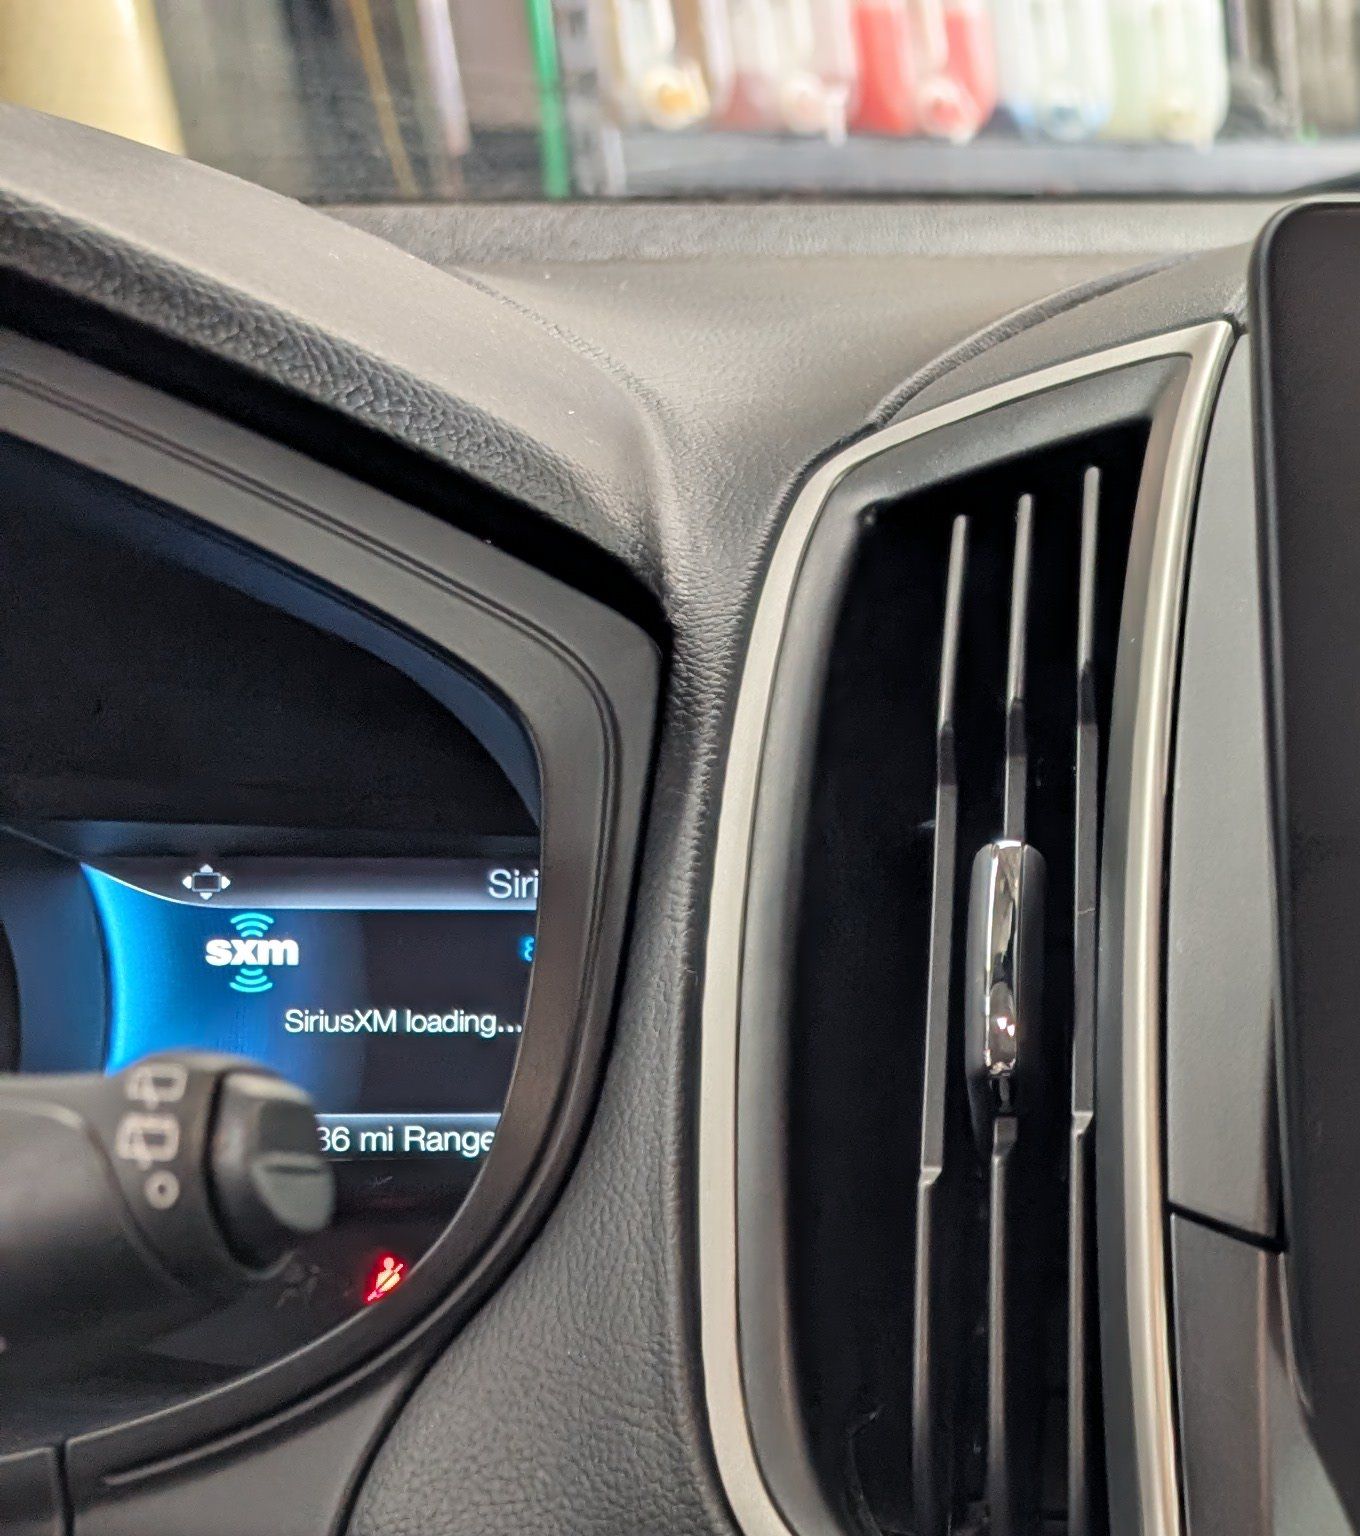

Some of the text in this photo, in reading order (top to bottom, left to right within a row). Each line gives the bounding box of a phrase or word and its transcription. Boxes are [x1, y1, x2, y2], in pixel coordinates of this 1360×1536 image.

[205, 936, 299, 967] sxm
[284, 1009, 523, 1038] SiriusXM loading...
[360, 1126, 393, 1151] mi
[404, 1126, 496, 1157] Range
